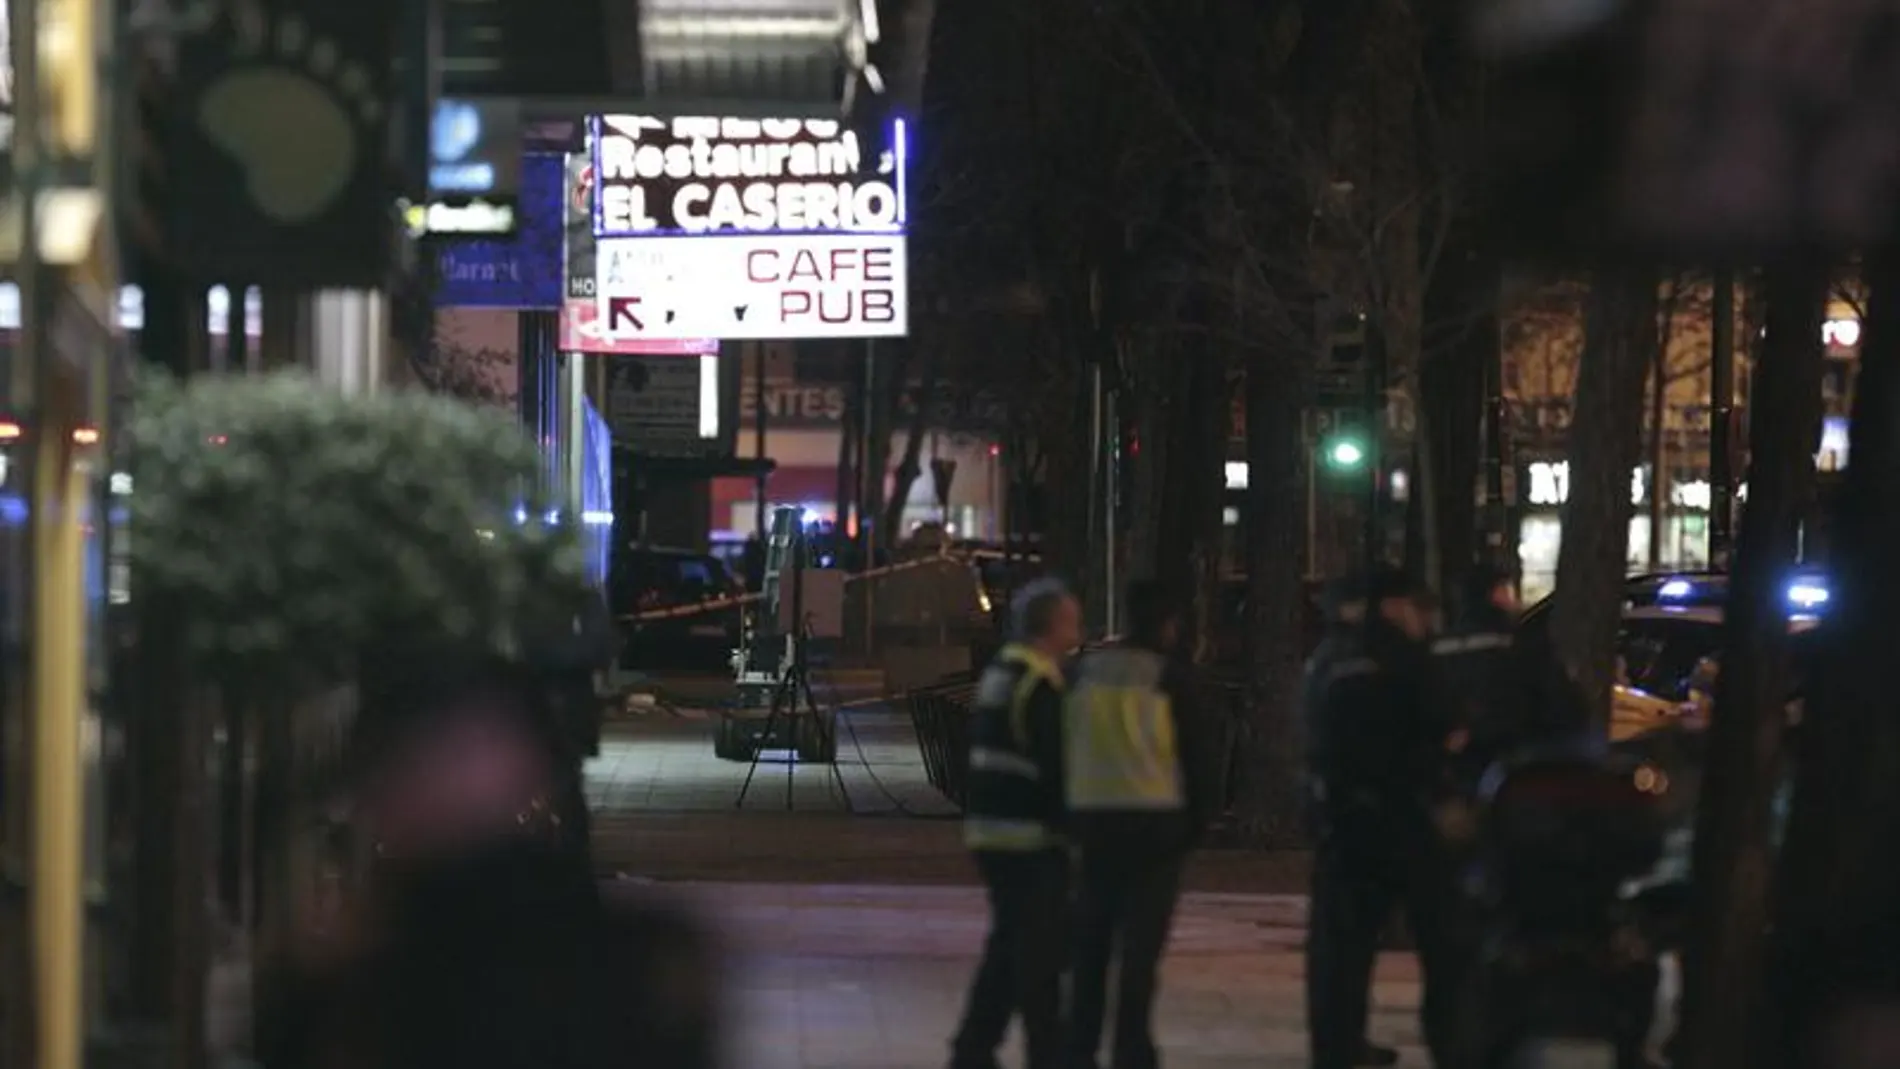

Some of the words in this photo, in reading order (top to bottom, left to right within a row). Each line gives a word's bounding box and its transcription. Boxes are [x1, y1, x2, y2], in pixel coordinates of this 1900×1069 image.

[602, 133, 893, 178] Restaurant
[603, 185, 657, 230] EL
[673, 184, 895, 231] CASERIO
[747, 249, 894, 282] CAFE
[780, 289, 896, 324] PUB
